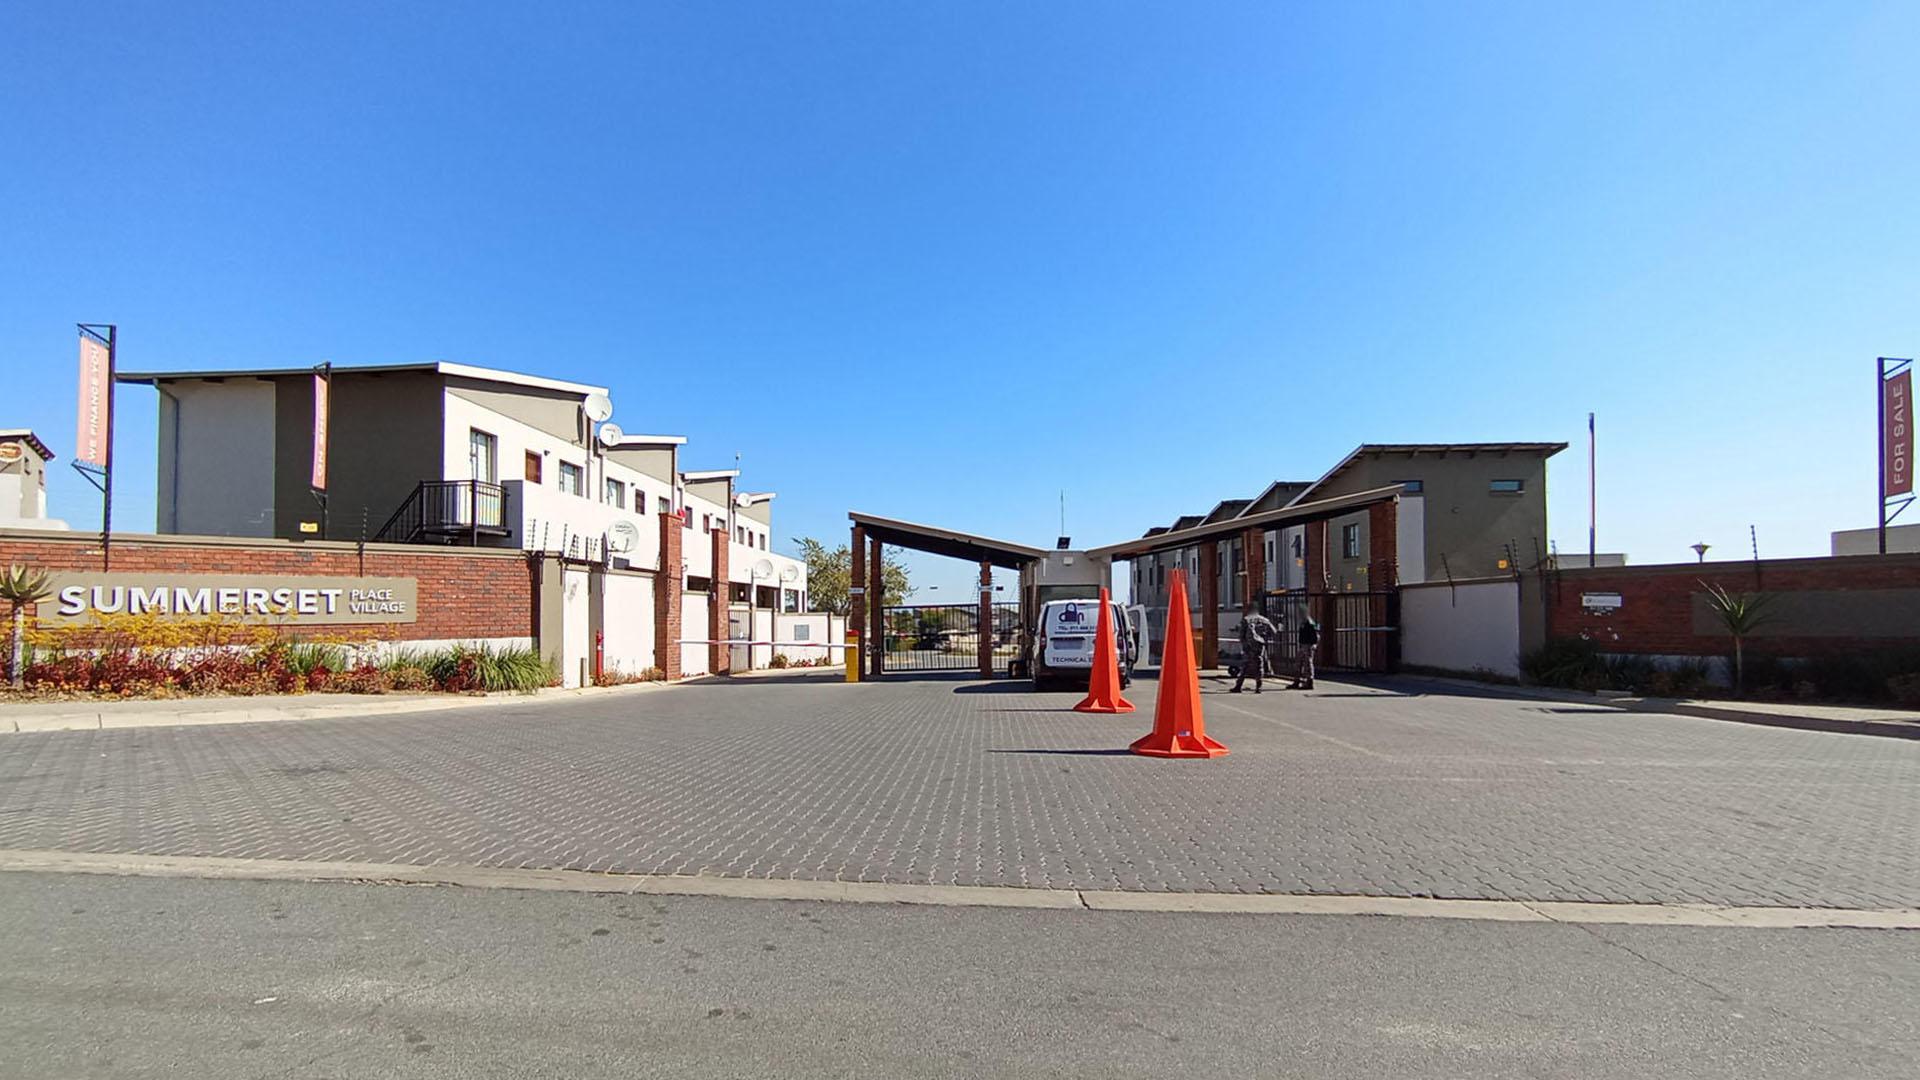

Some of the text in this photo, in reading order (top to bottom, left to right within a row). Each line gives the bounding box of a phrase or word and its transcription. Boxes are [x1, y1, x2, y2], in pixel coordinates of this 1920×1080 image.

[87, 344, 100, 460] WE FINANCE YOU
[1893, 382, 1905, 485] FOR SALE
[58, 585, 343, 615] SUMMERSET
[350, 588, 393, 601] PLACE
[350, 600, 407, 614] VILLAGE
